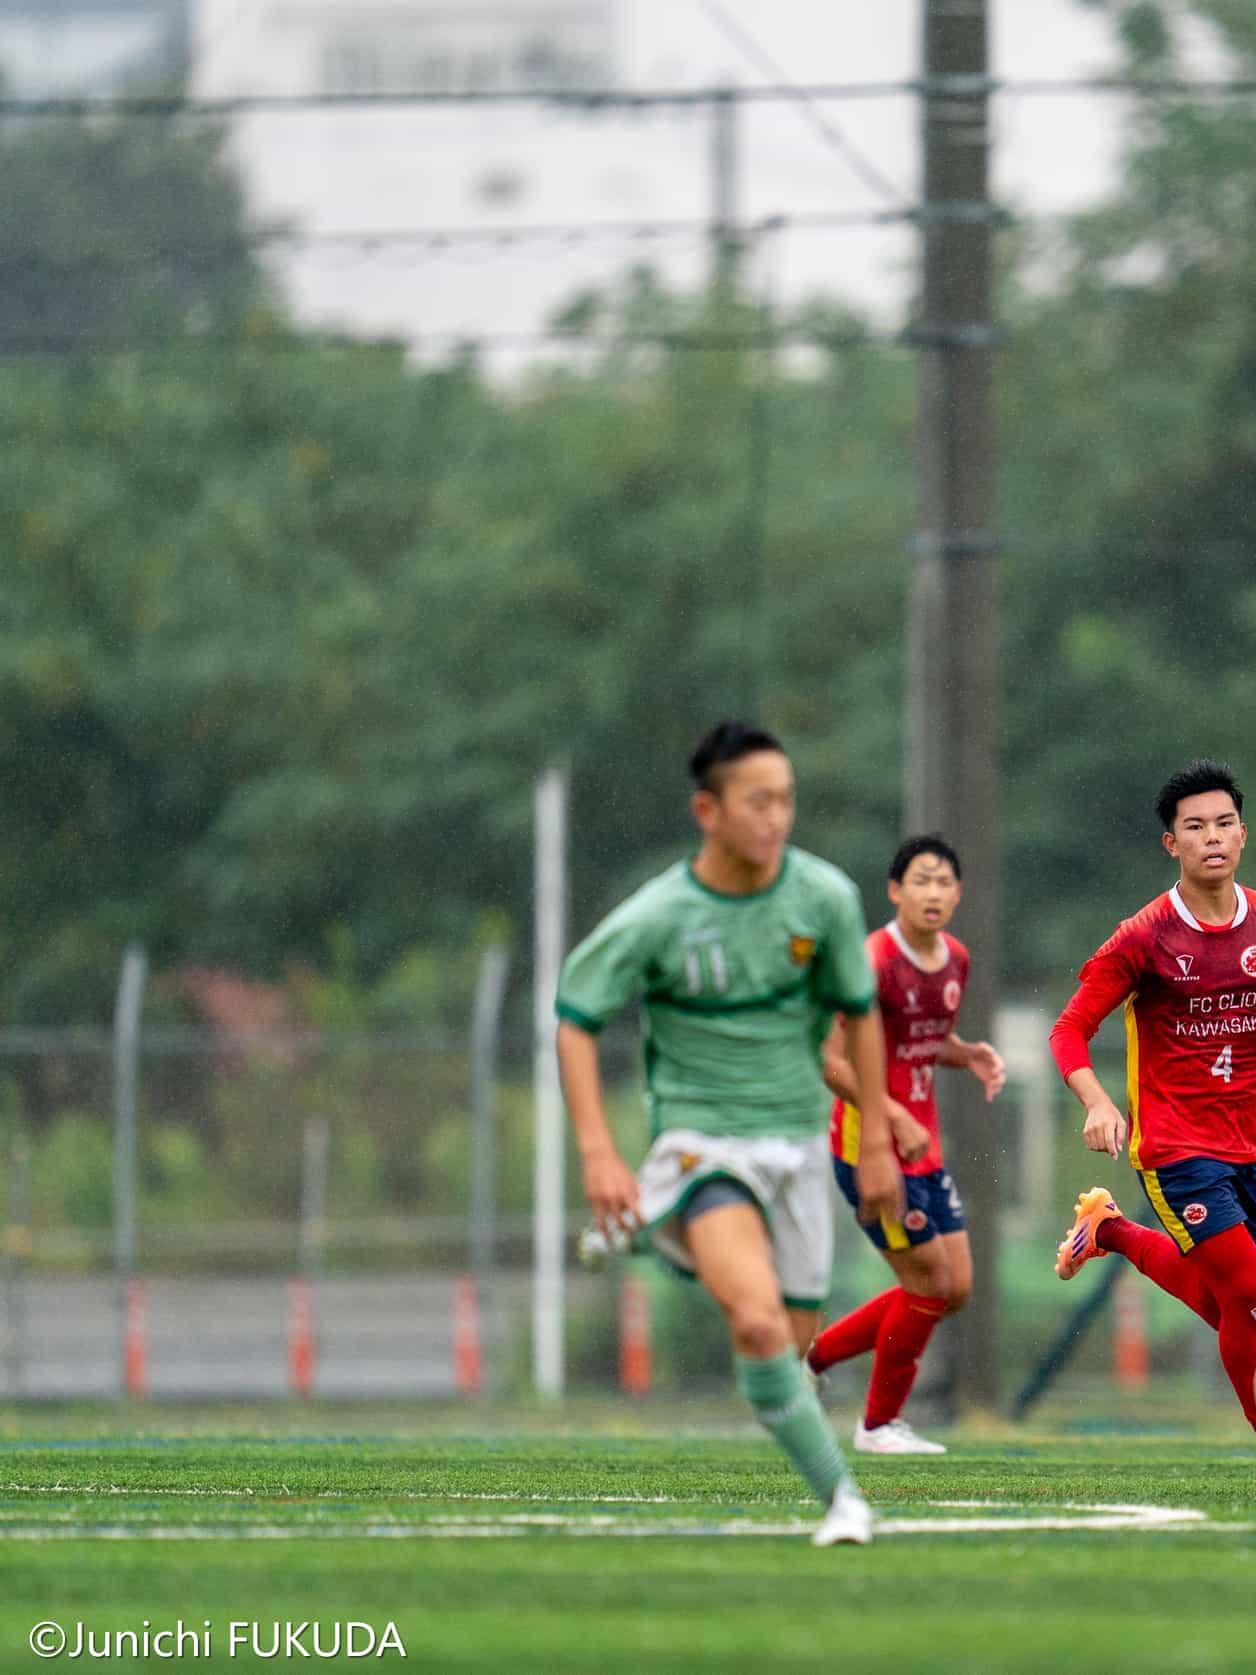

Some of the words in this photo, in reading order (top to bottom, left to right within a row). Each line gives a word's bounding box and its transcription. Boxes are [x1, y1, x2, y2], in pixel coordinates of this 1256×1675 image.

[1190, 997, 1212, 1013] FC
[1218, 992, 1256, 1010] CLIO
[1210, 1044, 1233, 1083] 4
